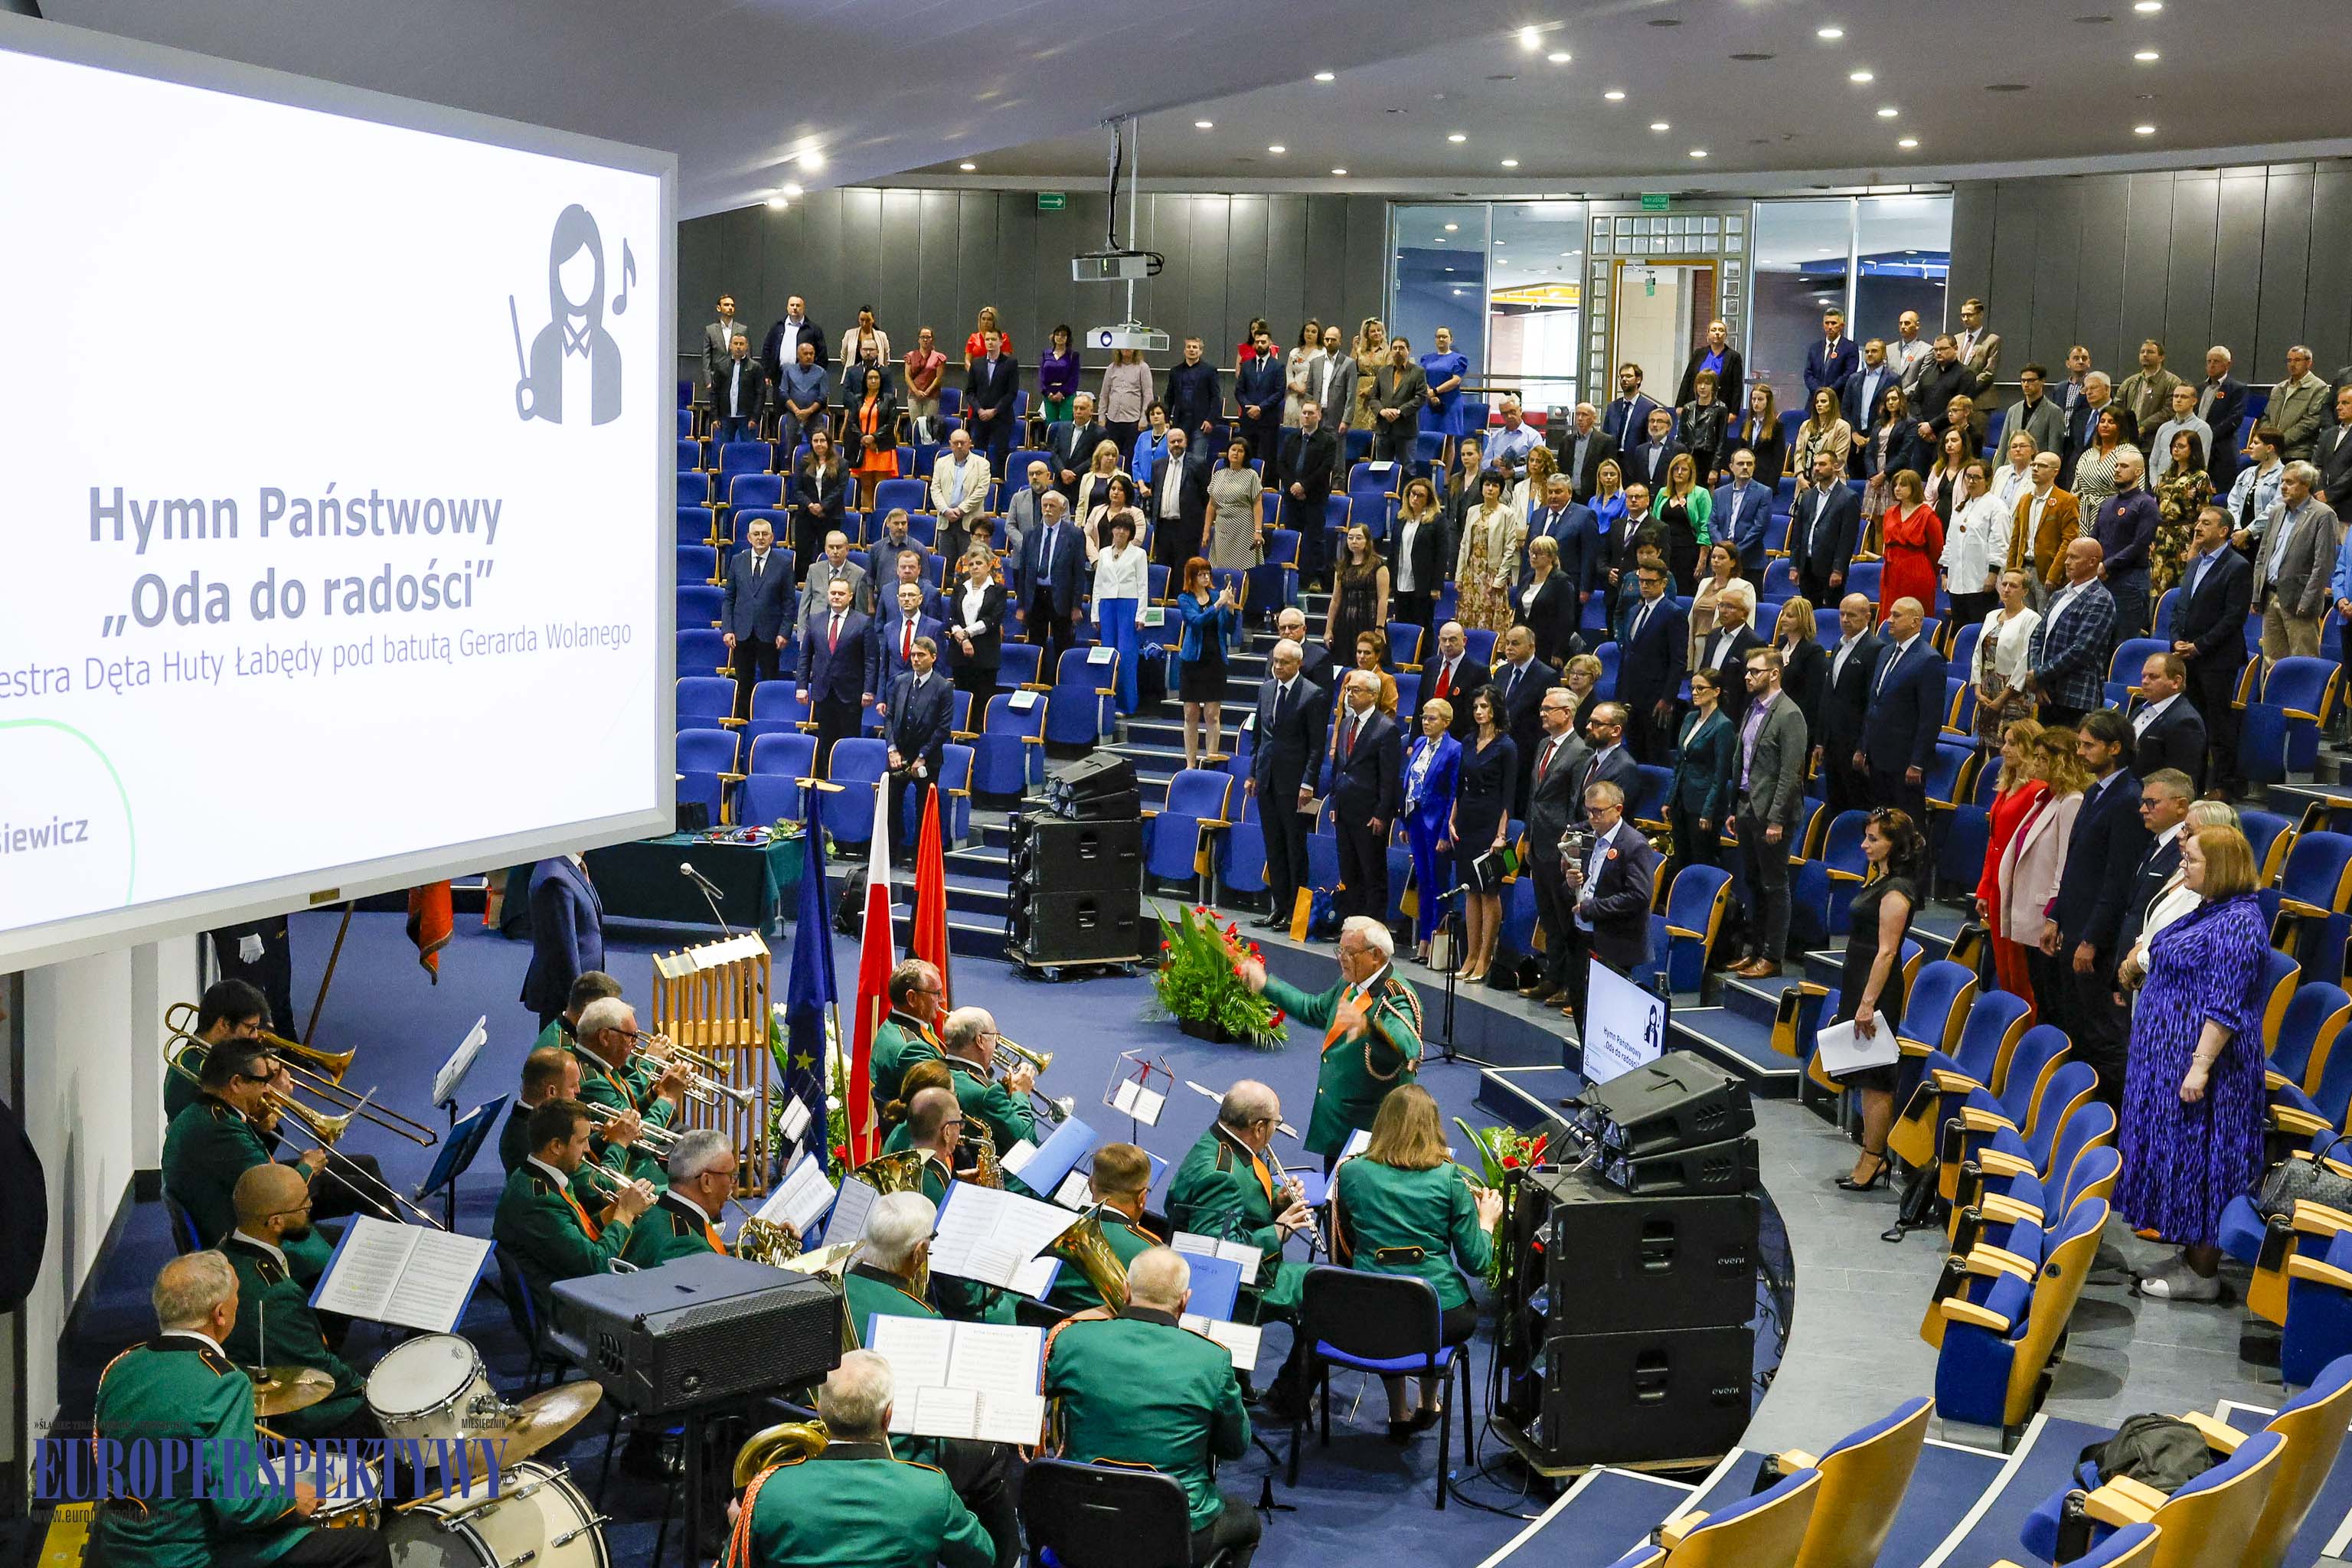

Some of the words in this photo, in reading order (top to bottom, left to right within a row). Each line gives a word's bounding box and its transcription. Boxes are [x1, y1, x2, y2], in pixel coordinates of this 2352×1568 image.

[90, 487, 238, 555] Hymn
[260, 482, 502, 545] Państwowy
[250, 567, 306, 621] do
[0, 663, 70, 698] estra
[85, 655, 150, 694] Dęta
[164, 649, 224, 686] Huty
[235, 640, 323, 679] Łabędy
[333, 635, 374, 675] pod
[384, 632, 453, 665] batutą
[459, 624, 537, 656] Gerarda
[545, 621, 632, 650] Wolanego
[0, 815, 89, 854] iewicz
[1603, 1025, 1616, 1040] Hymn
[1615, 1047, 1621, 1058] do
